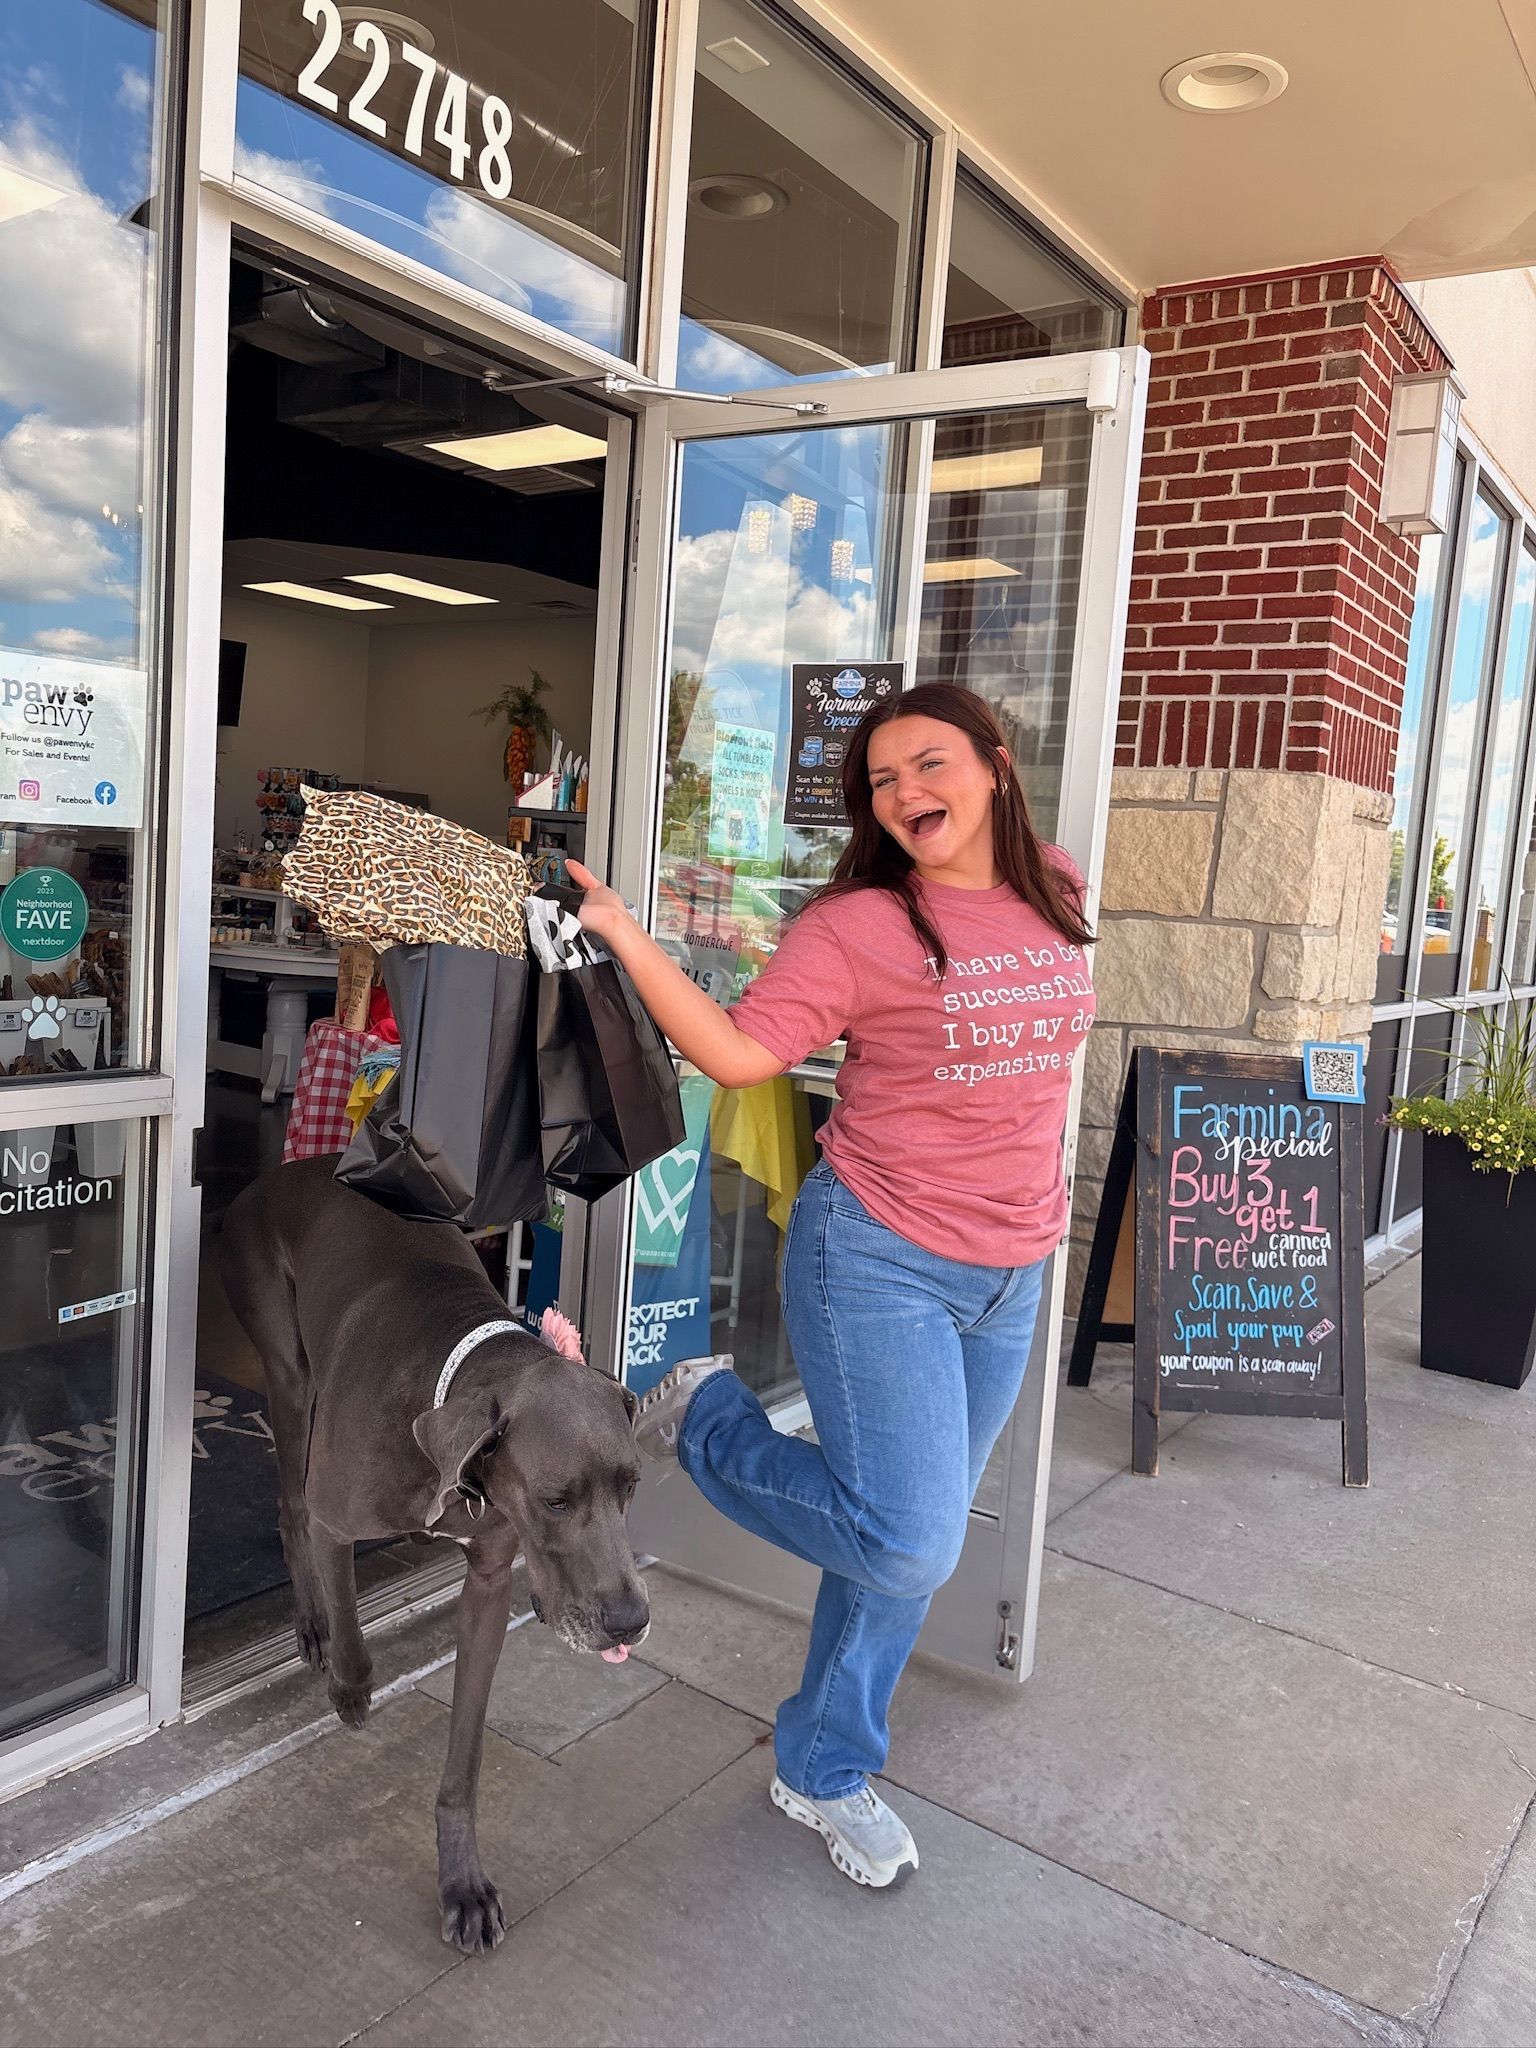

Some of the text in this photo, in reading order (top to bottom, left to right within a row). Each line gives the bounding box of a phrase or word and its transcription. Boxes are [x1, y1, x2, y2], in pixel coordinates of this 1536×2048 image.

[297, 0, 512, 200] 22748
[2, 678, 69, 706] paw
[23, 702, 94, 736] envy
[1, 732, 95, 750] Follow us @pawenvykc
[5, 748, 91, 762] For Sales and Events!
[796, 775, 811, 784] Scan
[812, 775, 823, 784] the
[823, 776, 835, 784] QR
[56, 795, 93, 805] Facebook
[16, 898, 73, 909] Neighborhood
[36, 887, 54, 895] 2023
[16, 909, 72, 930] FAVE
[22, 937, 66, 946] nextdoor
[948, 952, 1020, 977] have
[1023, 946, 1055, 968] to
[1053, 941, 1081, 963] be
[943, 972, 1095, 1014] successful
[942, 1008, 1095, 1050] I buy my do
[933, 1050, 1061, 1088] expensive
[1172, 1085, 1326, 1140] Farmina
[3, 1145, 51, 1177] No
[1214, 1120, 1334, 1175] Special
[1168, 1145, 1274, 1216] Buy 3
[1235, 1185, 1328, 1244] get 1
[1168, 1215, 1249, 1271] Free
[1269, 1232, 1332, 1251] canned
[1252, 1250, 1328, 1269] wet food
[1189, 1274, 1319, 1313] Scan, Save &
[629, 1297, 700, 1325] ROTECT
[628, 1322, 668, 1346] OUR
[1173, 1309, 1219, 1354] Spoil
[1227, 1321, 1268, 1351] your
[1272, 1323, 1304, 1348] pup
[626, 1343, 663, 1367] ACK
[1160, 1351, 1322, 1381] your coupon is a scan away!
